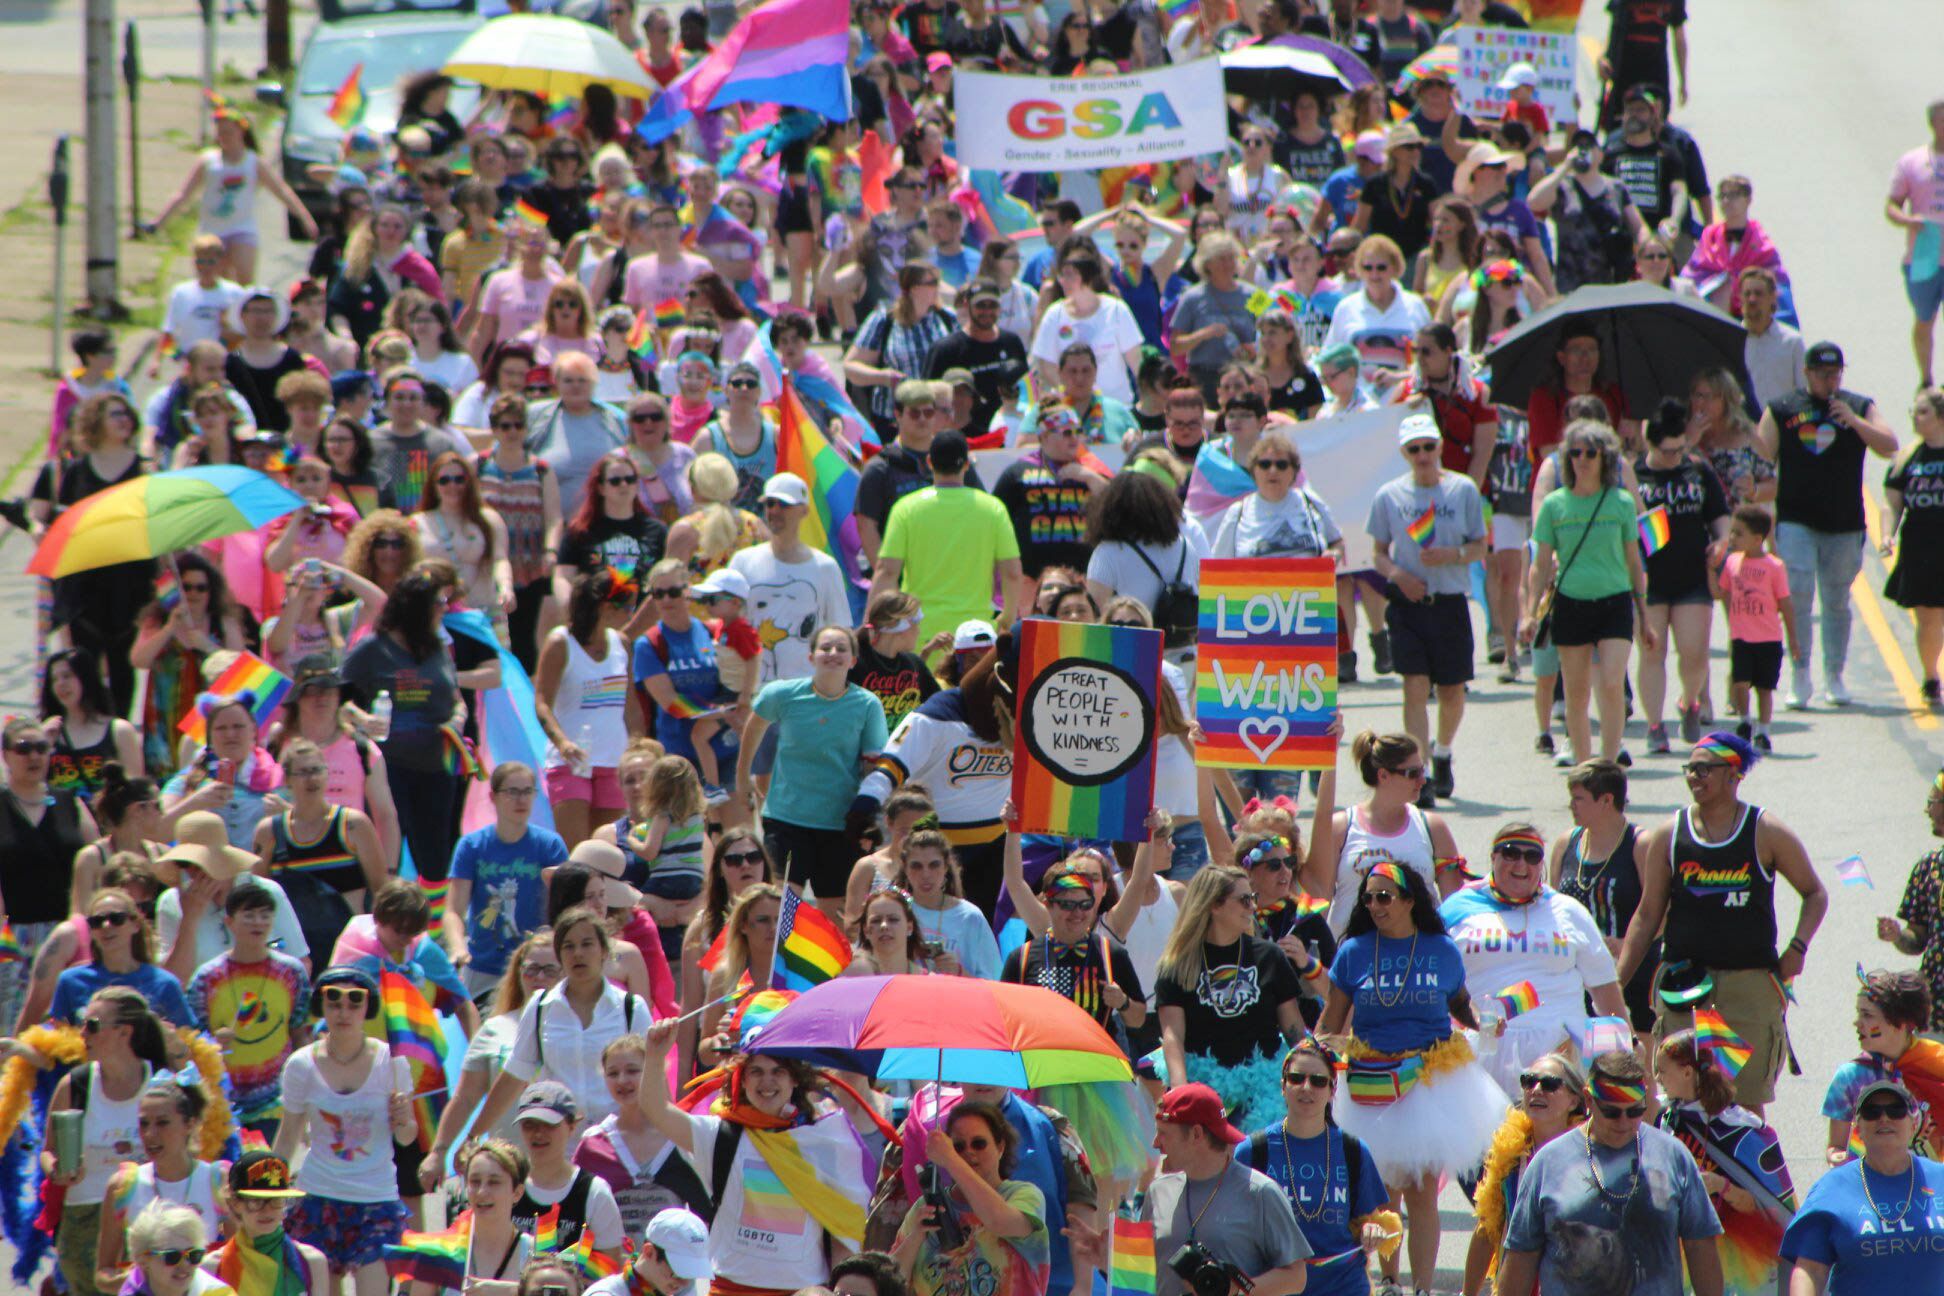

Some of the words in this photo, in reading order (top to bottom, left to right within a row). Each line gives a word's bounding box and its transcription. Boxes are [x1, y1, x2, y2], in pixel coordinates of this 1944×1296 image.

[1050, 82, 1079, 93] ERIE
[1081, 78, 1143, 92] REGIONAL
[1006, 91, 1183, 141] GSA
[1005, 149, 1051, 161] Gender
[1065, 146, 1121, 161] Sexuality
[1137, 138, 1186, 153] Alliance
[1026, 486, 1092, 513] STAY
[1030, 514, 1088, 544] GAY
[1216, 590, 1322, 638] LOVE
[668, 657, 702, 672] ALL
[1058, 672, 1109, 691] TREAT
[1212, 658, 1325, 714] WINS
[1047, 687, 1119, 715] PEOPLE
[1052, 713, 1110, 728] WITH
[1053, 732, 1120, 753] KINDNESS
[1680, 861, 1751, 887] Proud
[1724, 891, 1751, 907] AF
[1466, 927, 1568, 957] HUMAN
[1360, 973, 1404, 990] ALL
[1415, 972, 1438, 988] IN
[1360, 989, 1440, 1006] SERVICE
[1858, 1196, 1944, 1217] ABOVE
[1860, 1218, 1915, 1235] ALL
